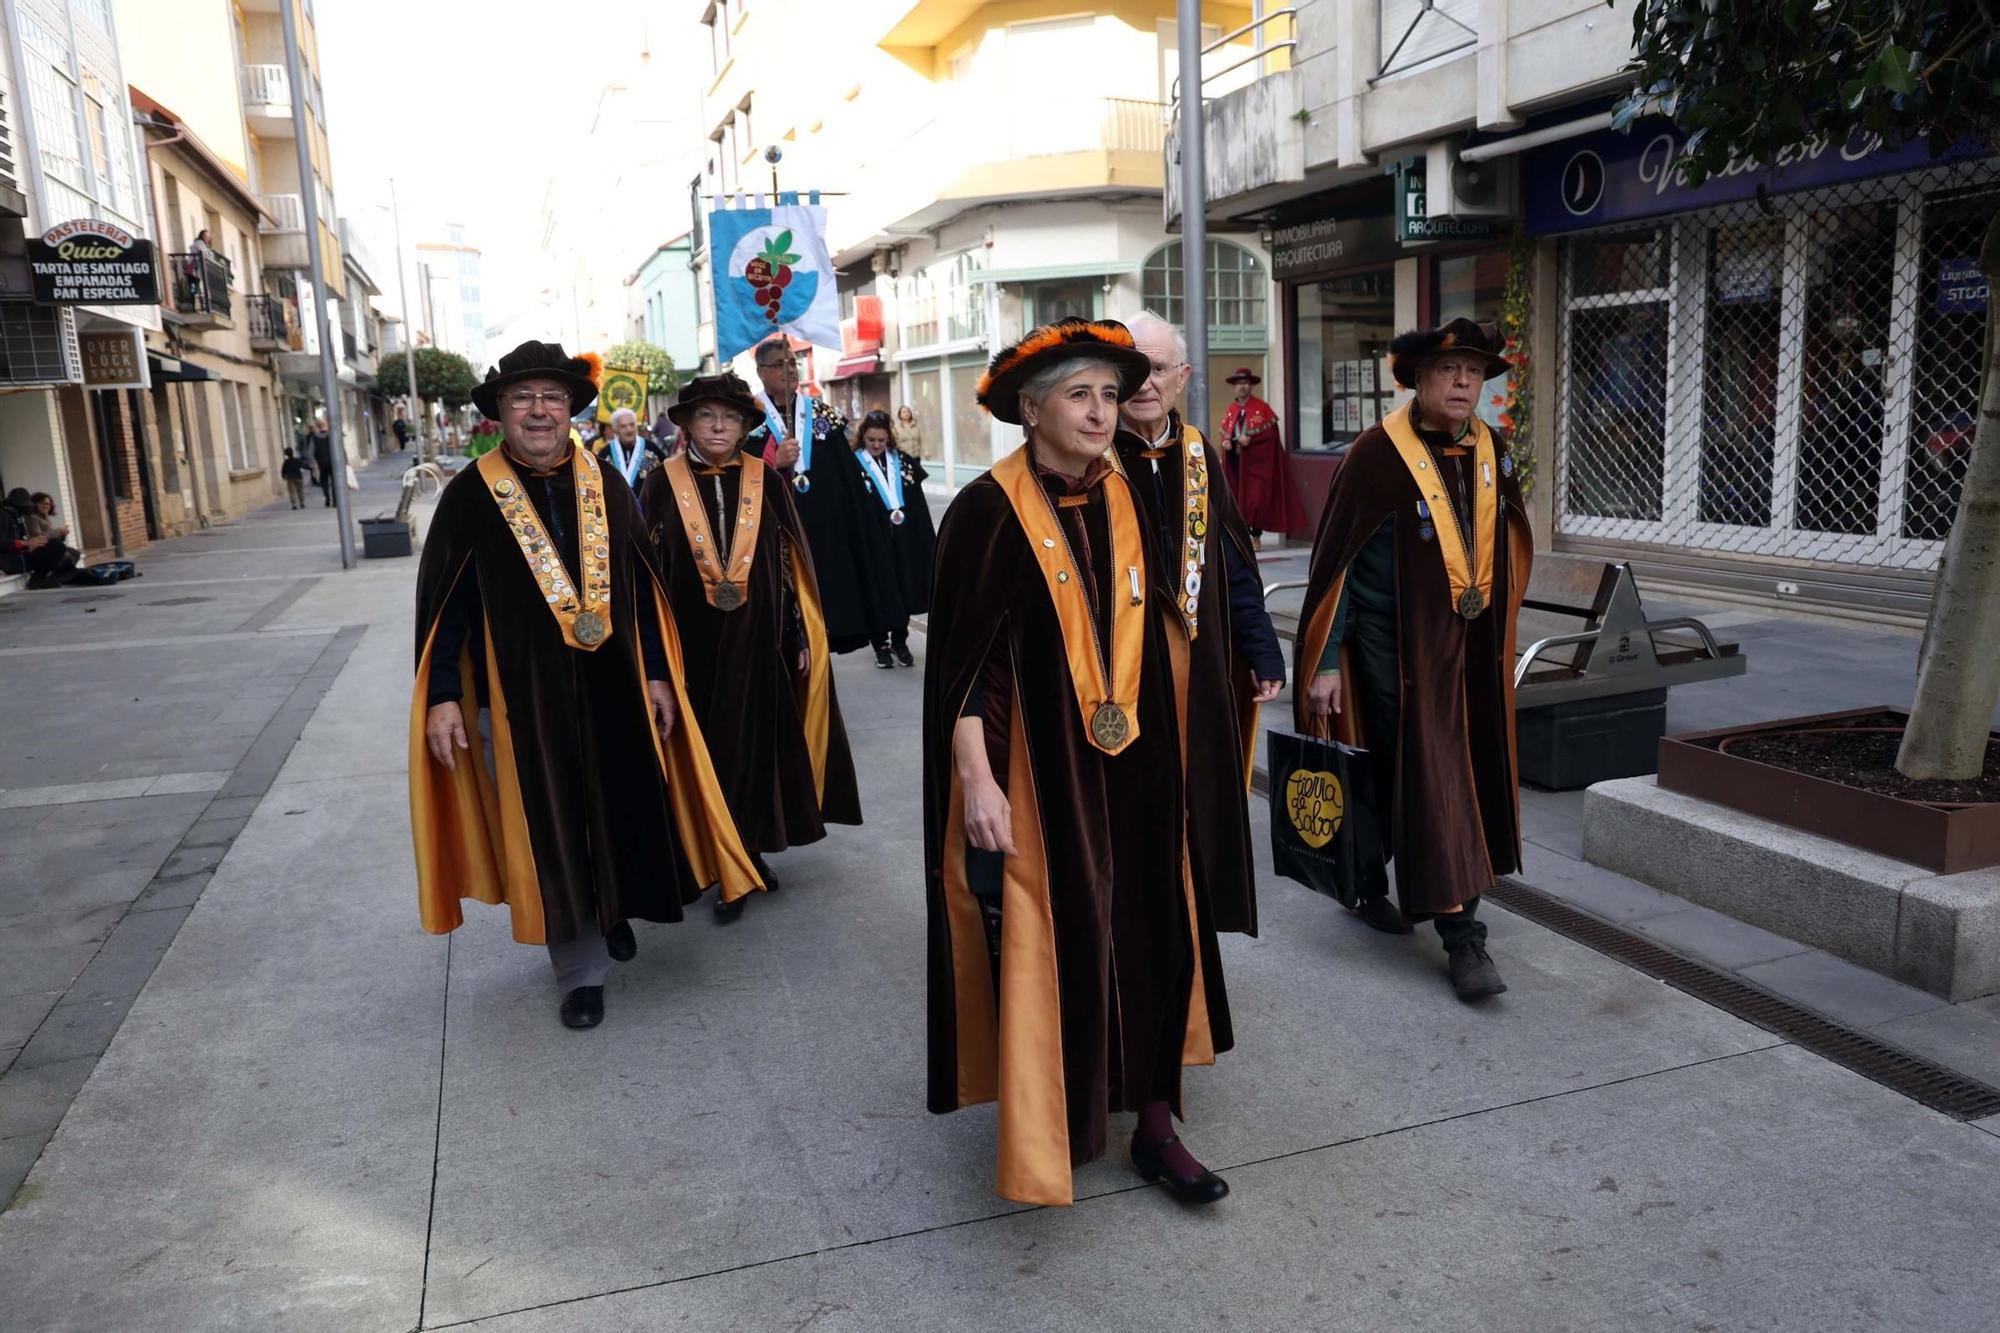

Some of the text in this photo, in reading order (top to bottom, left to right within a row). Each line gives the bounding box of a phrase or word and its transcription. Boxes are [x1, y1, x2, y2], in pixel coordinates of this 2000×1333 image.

[47, 221, 129, 245] PASTELERIA
[1274, 217, 1336, 245] INMOBILIARIA
[1408, 220, 1489, 236] ARQUITECTURA
[58, 241, 123, 260] Quico
[1274, 240, 1343, 268] ARQUITECTURA
[32, 263, 150, 274] TARTA DE SANTIAGO
[55, 275, 132, 287] EMPANADAS
[54, 288, 140, 299] PAN ESPECIAL
[87, 340, 129, 353] OVER
[89, 354, 132, 367] LOCK
[91, 368, 133, 378] SHOPS
[1292, 797, 1307, 810] de
